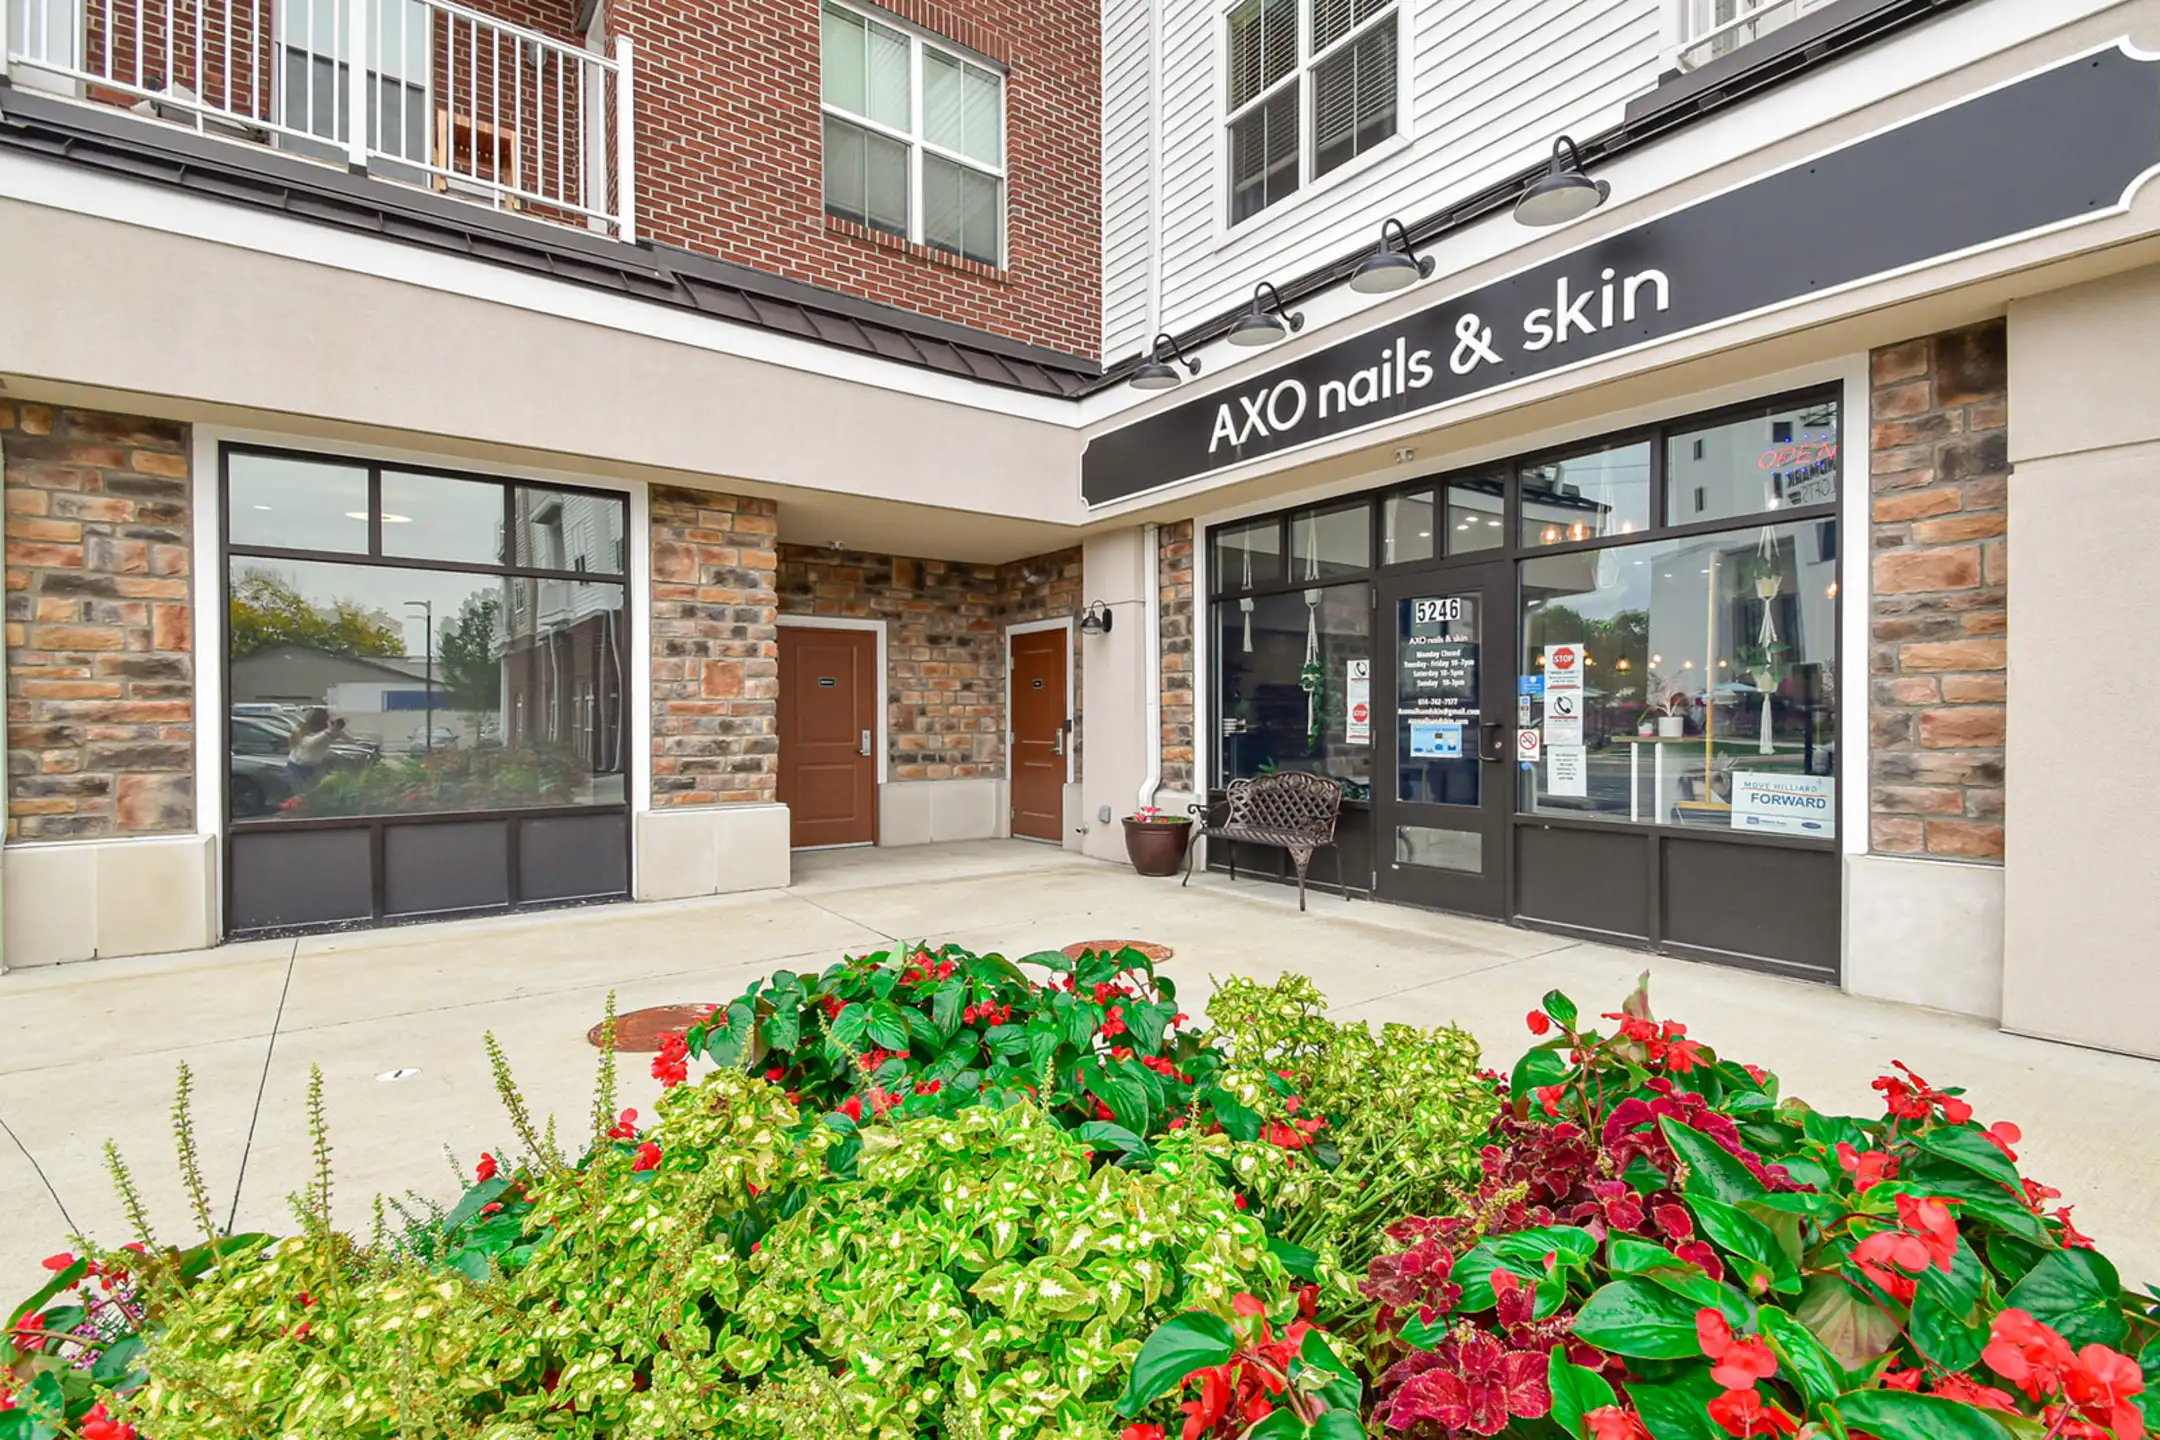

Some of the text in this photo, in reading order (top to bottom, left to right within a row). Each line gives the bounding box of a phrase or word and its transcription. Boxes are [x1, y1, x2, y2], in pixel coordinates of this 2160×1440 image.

[1208, 267, 1670, 455] AXO nails & skin
[1757, 441, 1839, 470] OPEN
[1417, 599, 1459, 621] 5246
[1409, 636, 1427, 645] AXO
[1427, 635, 1444, 644] nails
[1453, 633, 1469, 643] skin
[1416, 649, 1461, 659] Monday Closed
[1554, 654, 1574, 663] STOP
[1430, 660, 1450, 668] Friday
[1413, 670, 1439, 678] Saturday
[1416, 680, 1439, 688] Sunday
[1743, 781, 1818, 793] MOVE HILLIARD
[1750, 793, 1826, 809] FORWARD
